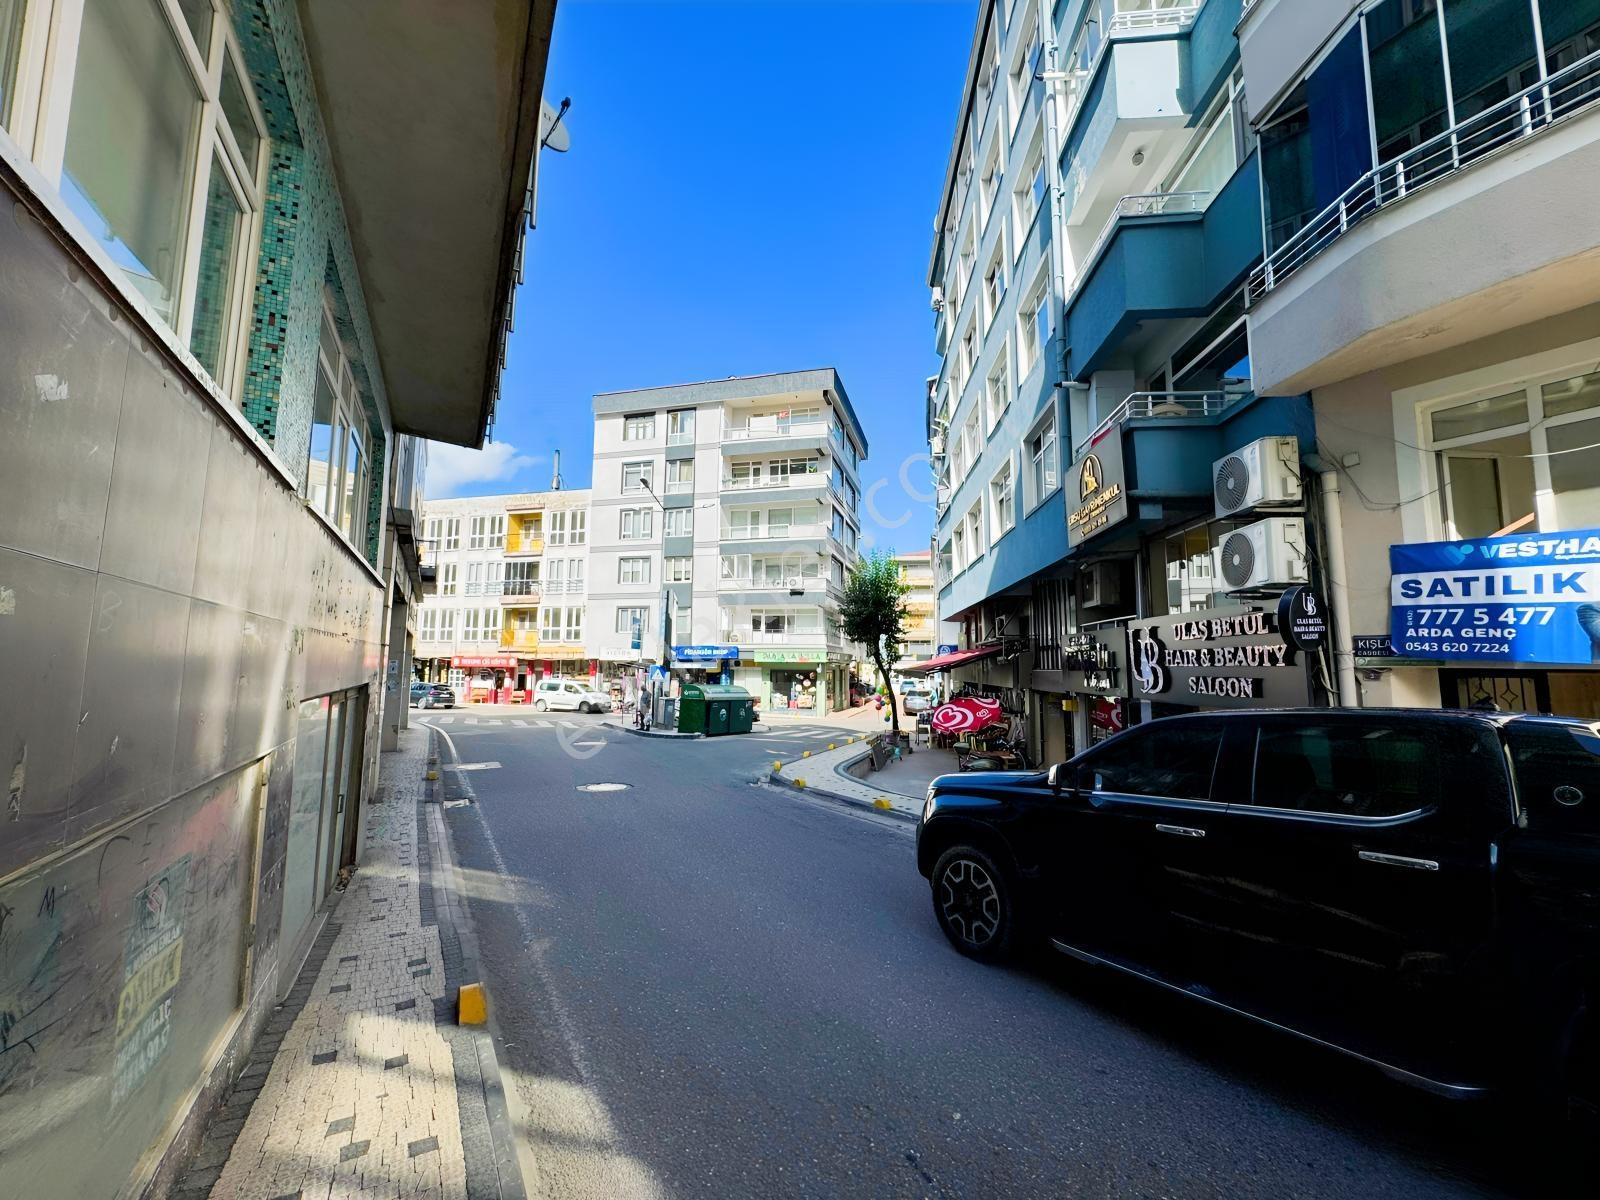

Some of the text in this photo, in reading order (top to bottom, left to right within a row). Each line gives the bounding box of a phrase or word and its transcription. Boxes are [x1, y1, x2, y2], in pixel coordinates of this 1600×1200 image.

[1480, 537, 1600, 558] VESTHA
[1400, 571, 1587, 599] SATILIK
[1416, 608, 1464, 626] 777
[1473, 608, 1489, 625] 5
[1498, 606, 1556, 626] 477
[1171, 622, 1208, 641] ULAŞ
[1405, 628, 1517, 640] ARDA GENÇ
[1358, 639, 1391, 650] KIŞLA
[1405, 642, 1510, 653] 0543 620 7224
[1165, 644, 1287, 667] HAIR & BEAUTY
[1188, 676, 1253, 698] SALOON
